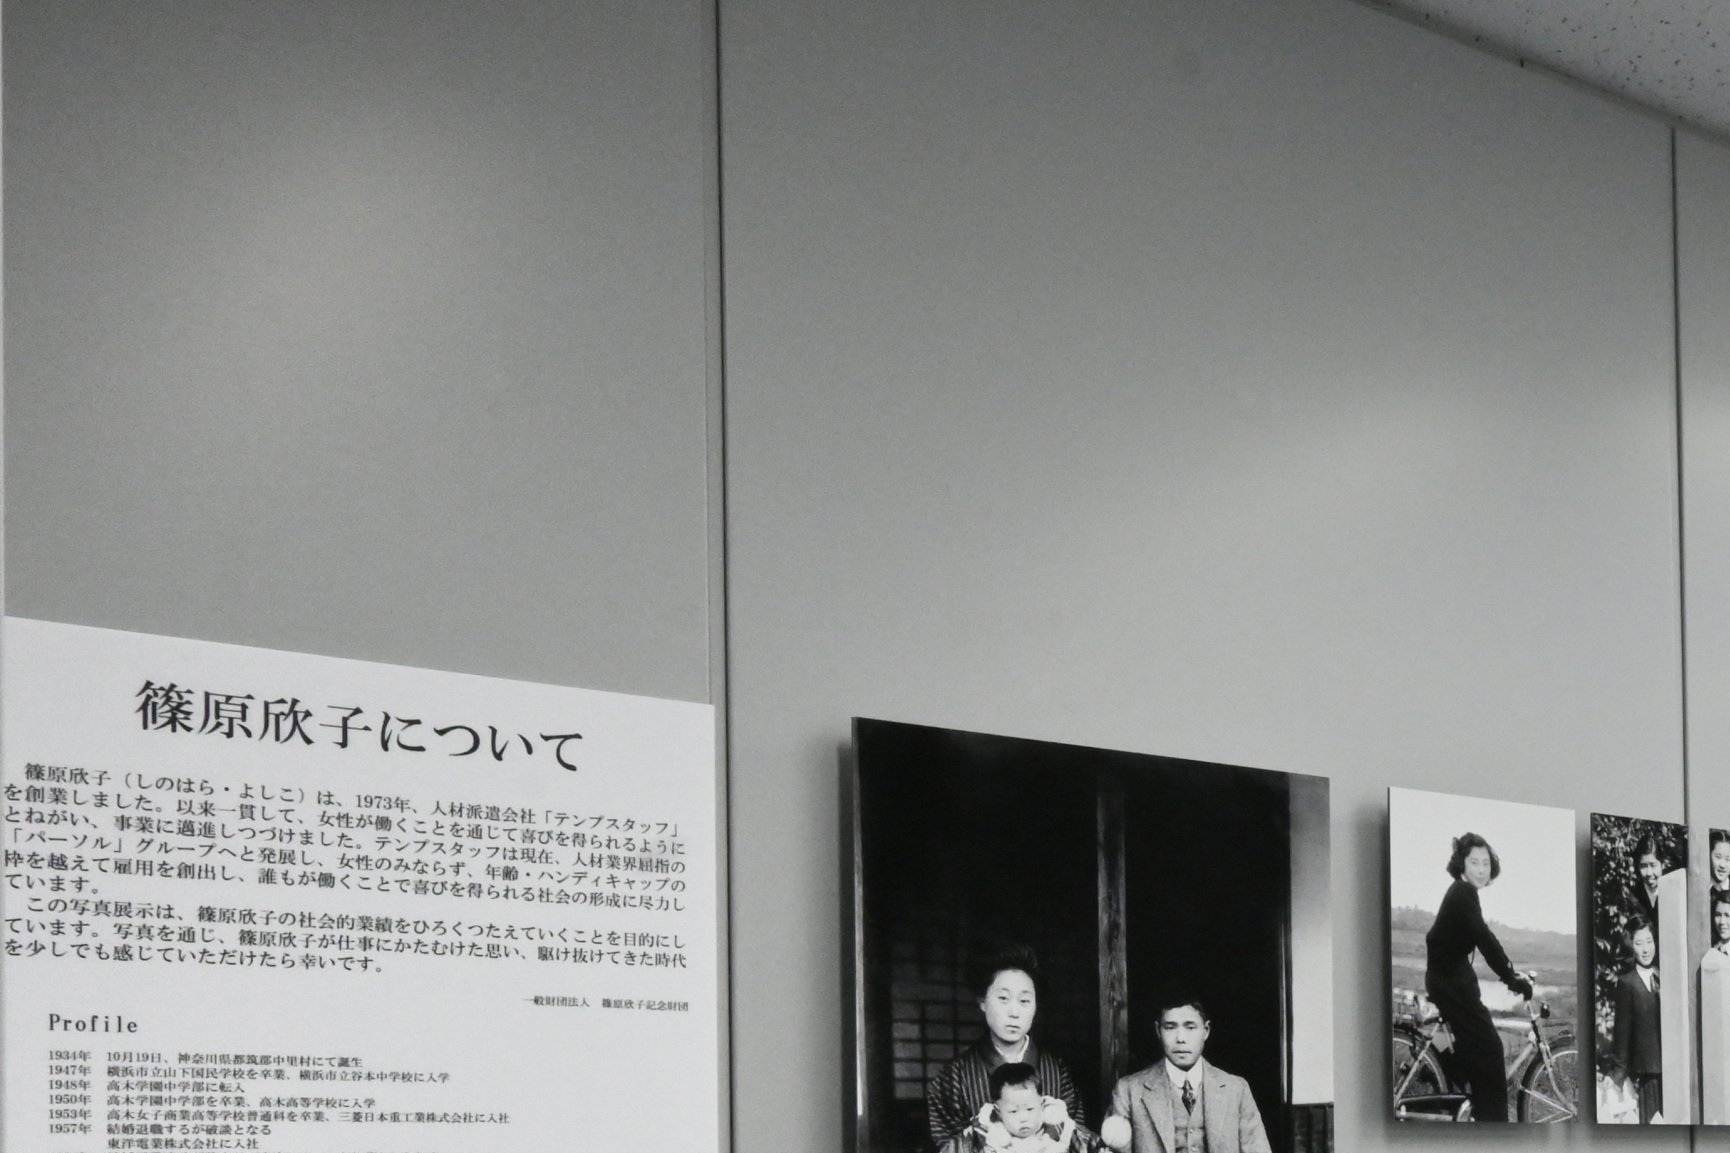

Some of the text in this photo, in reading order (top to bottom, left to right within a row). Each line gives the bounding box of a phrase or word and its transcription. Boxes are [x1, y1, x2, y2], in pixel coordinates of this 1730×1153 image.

[133, 679, 584, 773] 篠原欣子について
[4, 873, 99, 895] ています。
[48, 1013, 138, 1034] Profile
[48, 1049, 92, 1063] 1934年
[48, 1064, 92, 1078] 1947年
[48, 1078, 92, 1092] 1948年
[48, 1093, 93, 1107] 1950年
[48, 1108, 93, 1121] 1953年
[49, 1122, 93, 1136] 1957年
